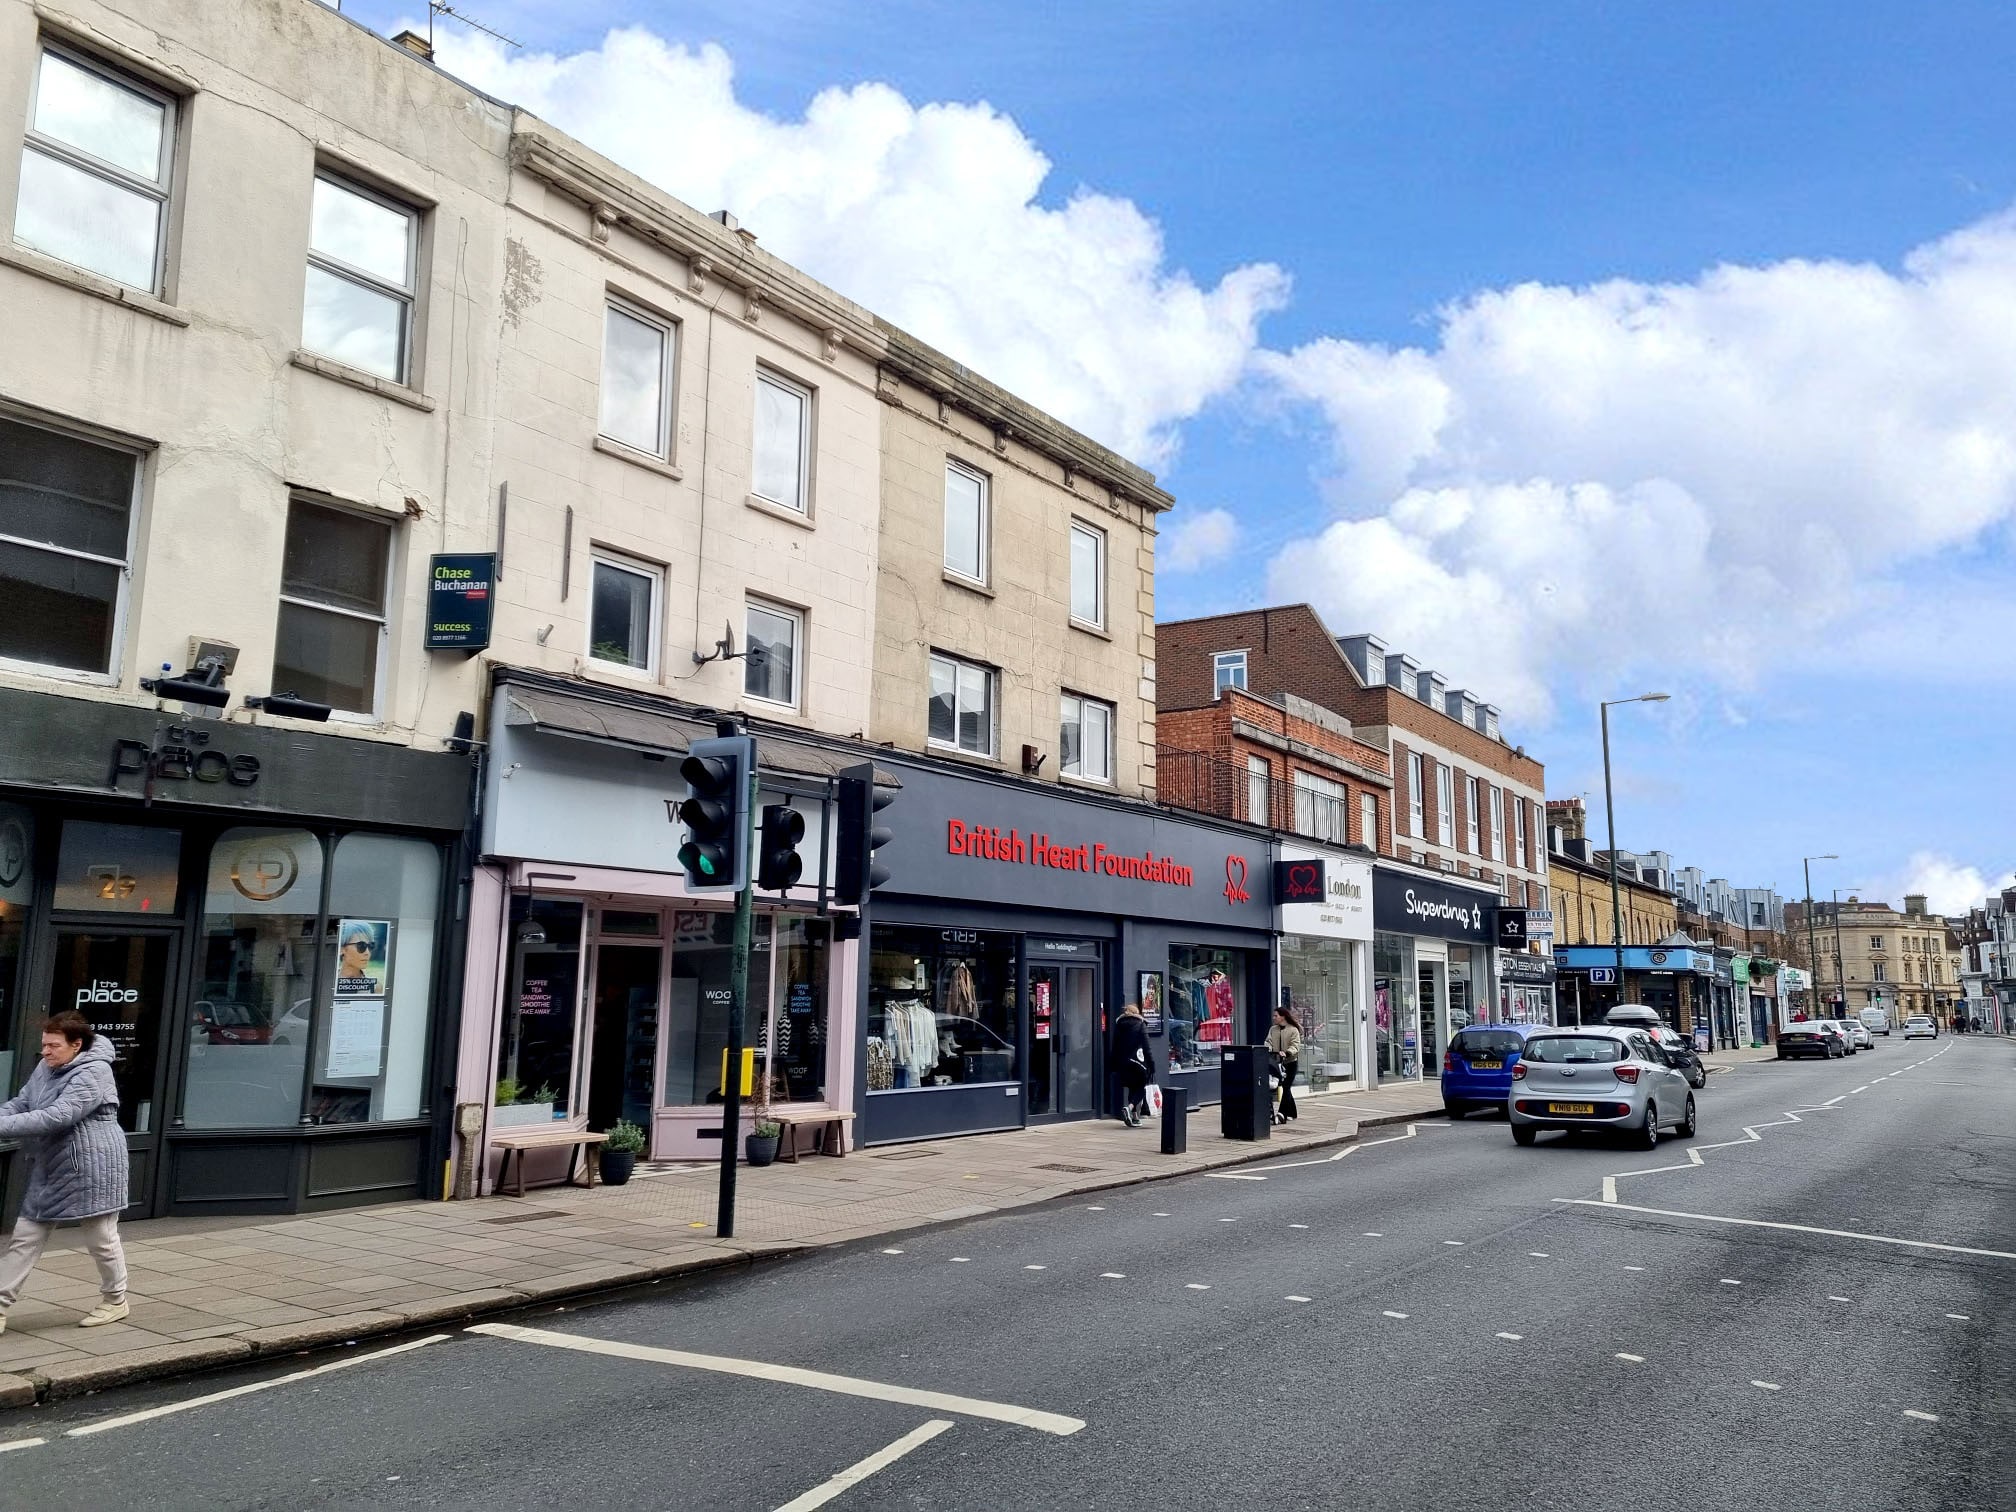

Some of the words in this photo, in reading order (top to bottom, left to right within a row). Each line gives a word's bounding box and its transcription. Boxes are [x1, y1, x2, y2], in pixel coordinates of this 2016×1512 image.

[434, 566, 472, 579] Chase
[434, 579, 488, 591] Buchanan
[432, 623, 472, 632] success
[168, 723, 210, 746] the
[109, 719, 261, 807] place
[948, 819, 1026, 864] British
[1031, 832, 1090, 873] Heart
[1093, 843, 1194, 887] Foundation
[97, 873, 136, 900] 29
[1327, 875, 1362, 899] London
[1405, 888, 1470, 930] Superdrug
[1595, 971, 1603, 980] P
[76, 979, 139, 1010] place
[705, 990, 732, 1000] WOO
[97, 1023, 114, 1031] 943
[115, 1023, 135, 1031] 9755
[1572, 1103, 1589, 1112] GUX
